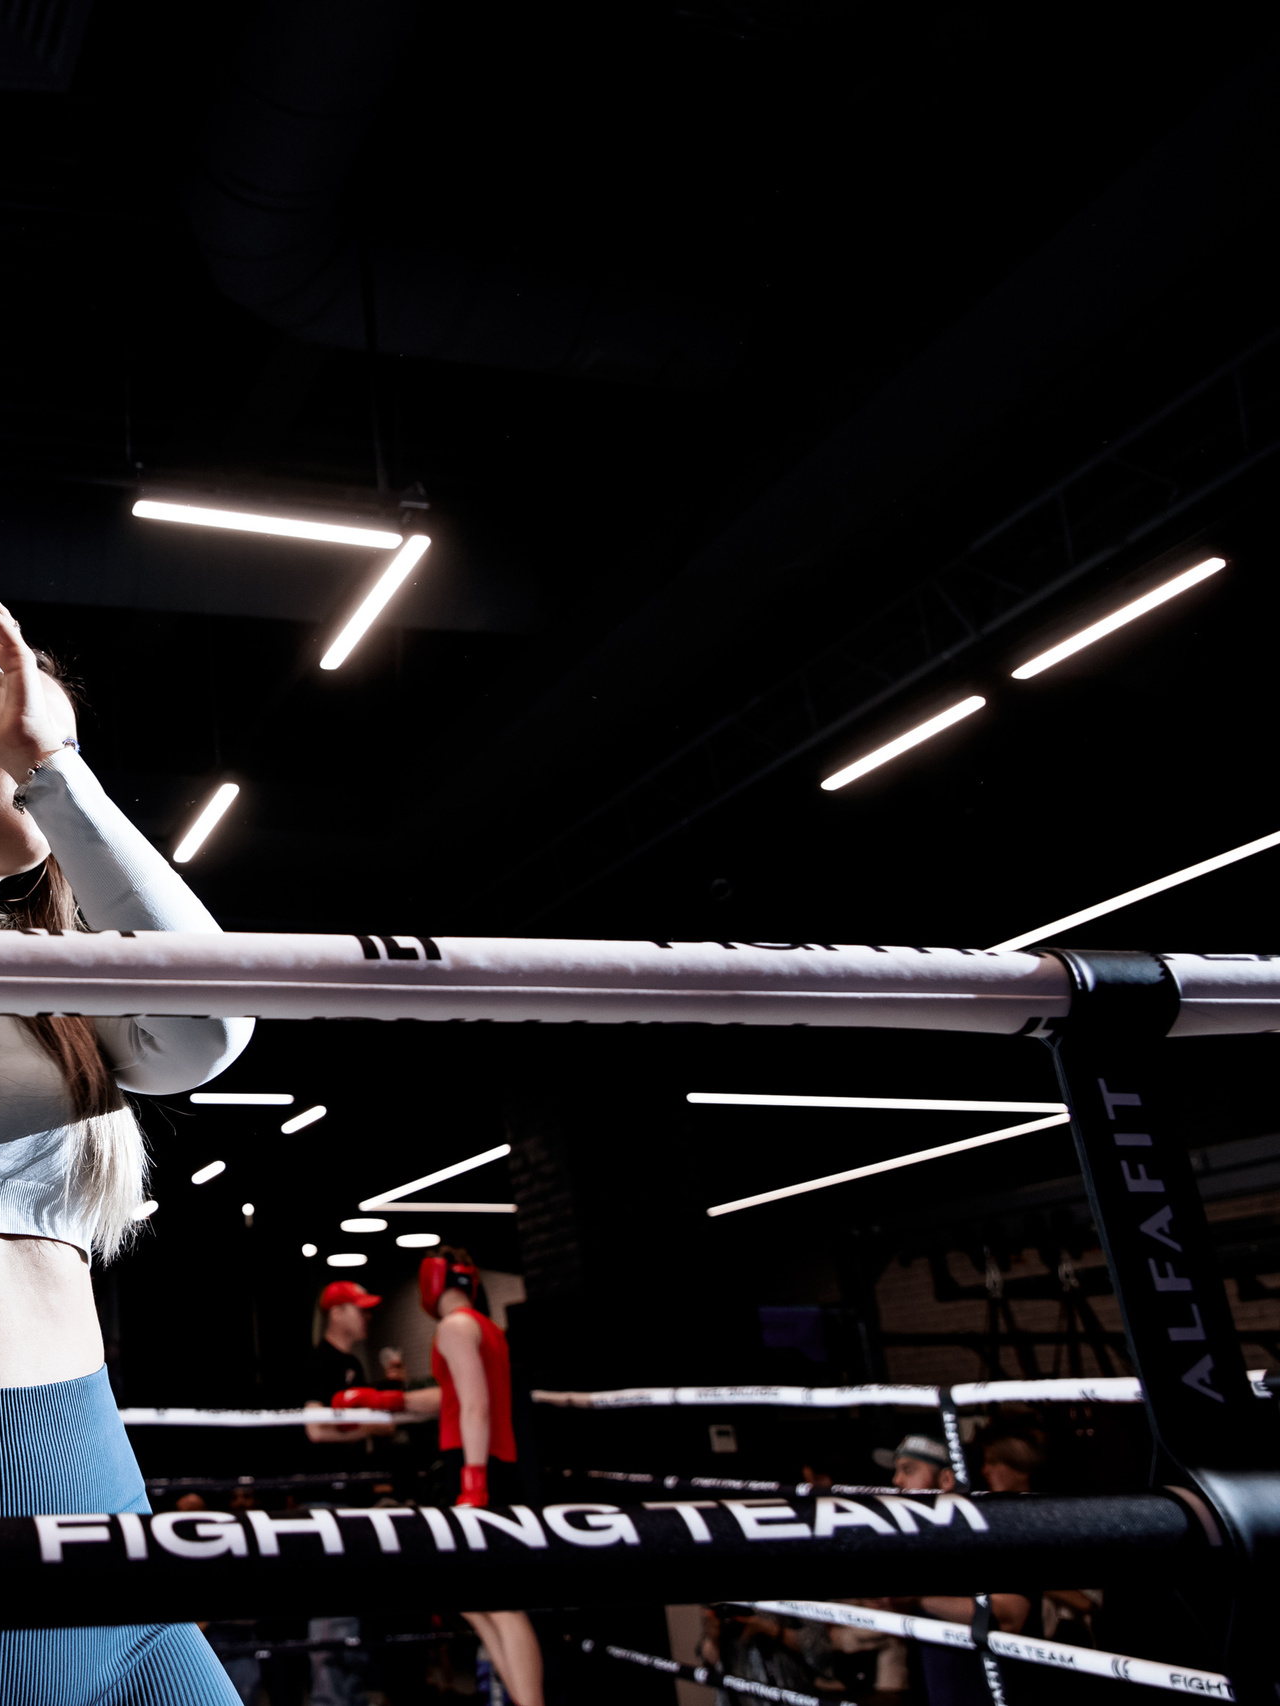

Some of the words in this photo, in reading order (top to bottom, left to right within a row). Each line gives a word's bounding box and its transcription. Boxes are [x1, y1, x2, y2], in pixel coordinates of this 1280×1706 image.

[1096, 1077, 1227, 1404] ALFAFIT
[33, 1502, 641, 1563] FIGHTING
[641, 1495, 990, 1544] TEAM
